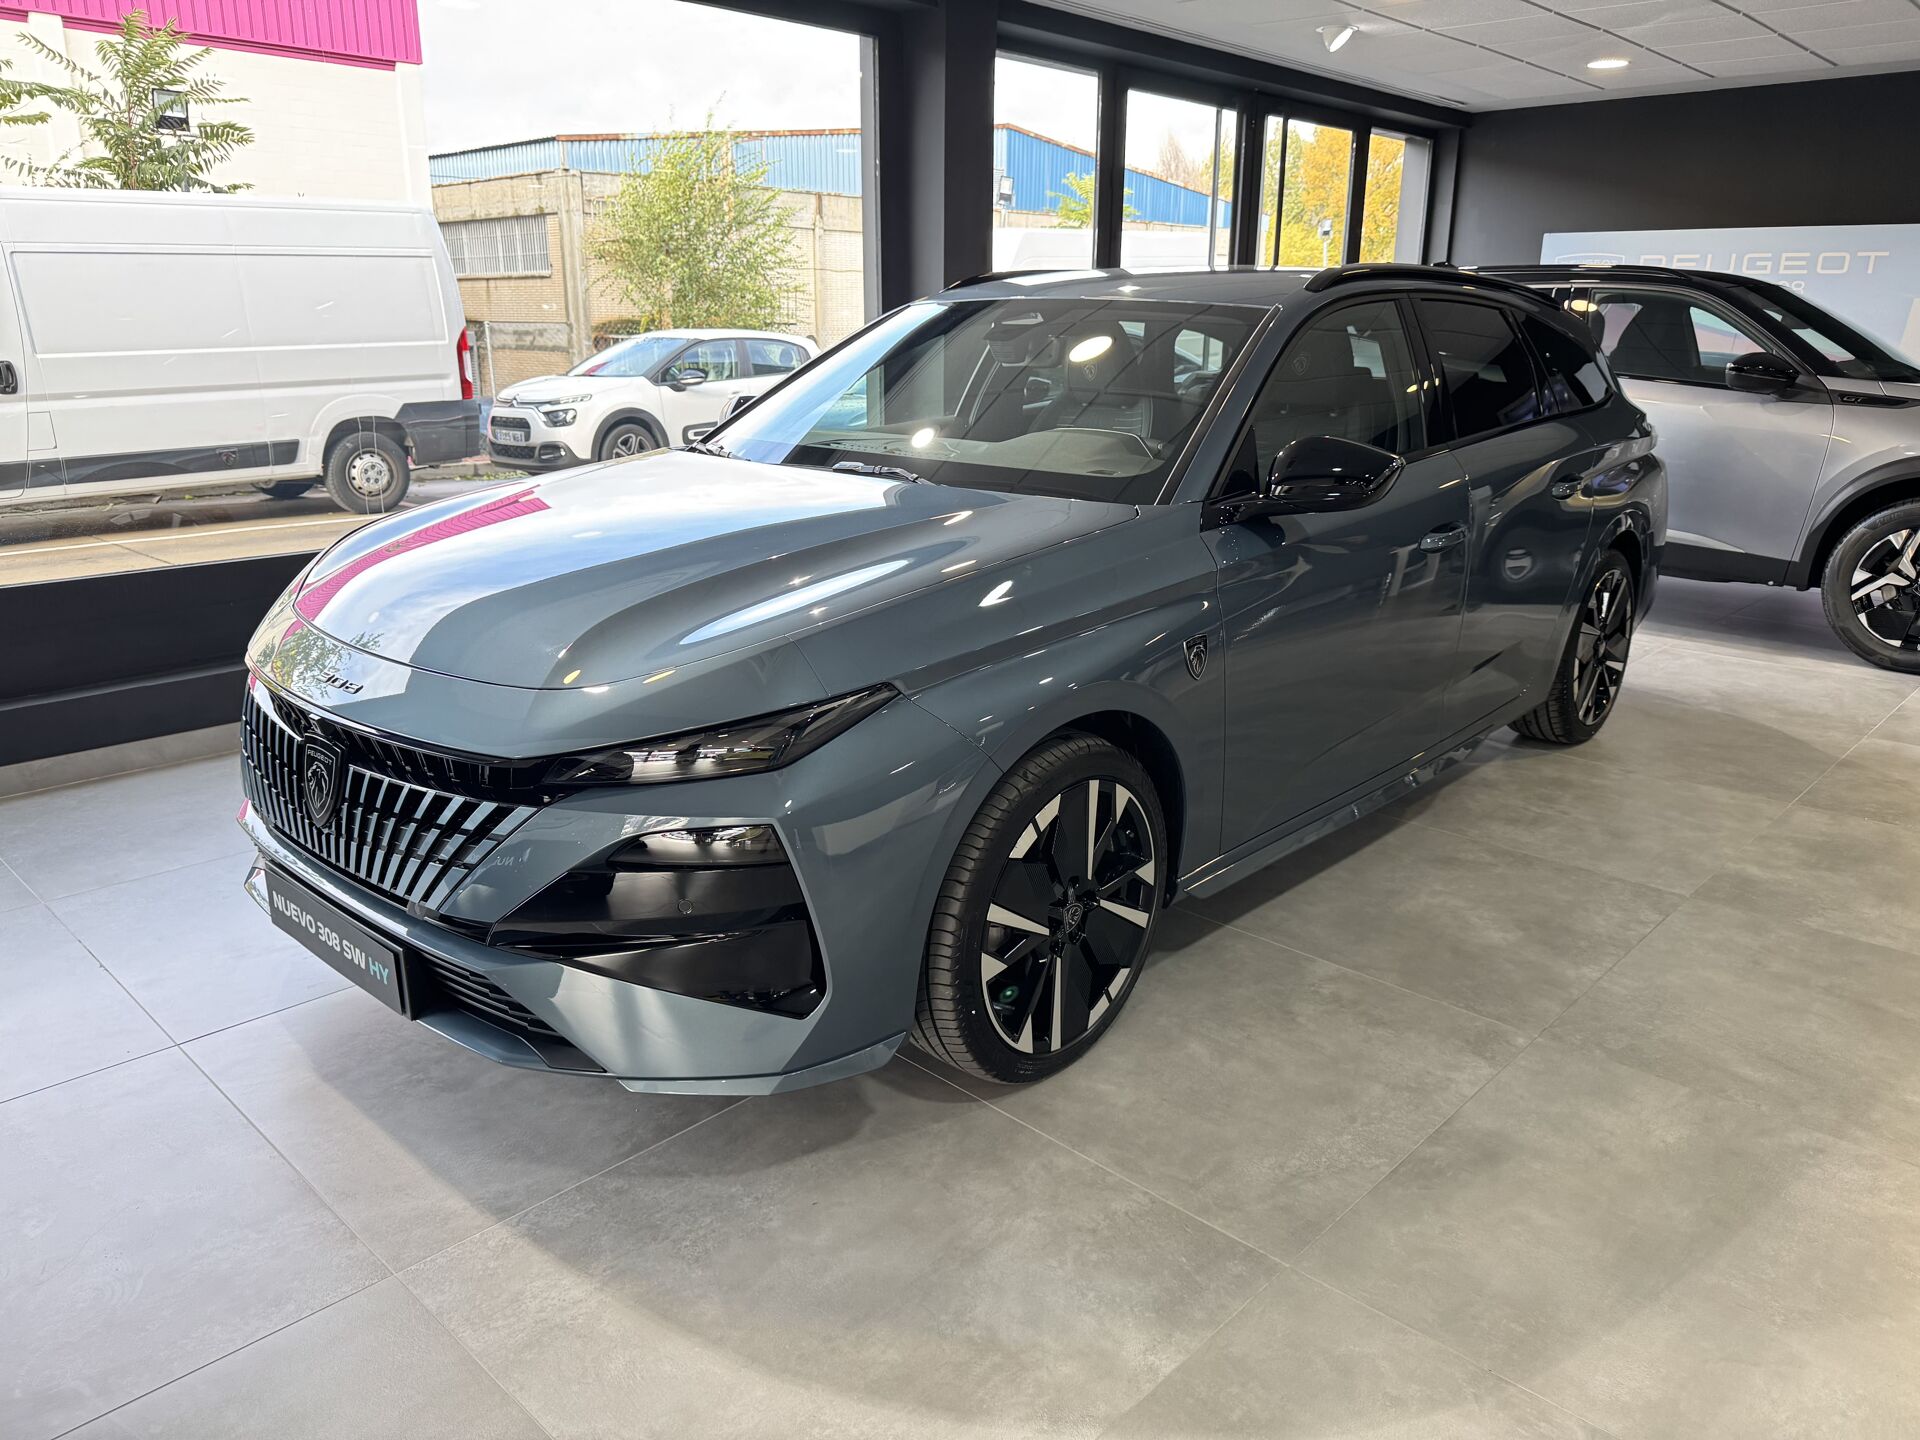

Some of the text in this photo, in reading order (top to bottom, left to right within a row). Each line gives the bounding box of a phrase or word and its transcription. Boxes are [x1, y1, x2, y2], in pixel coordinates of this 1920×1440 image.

[1639, 251, 1890, 274] PEUGEOT
[317, 672, 363, 694] 308
[307, 749, 333, 766] PEUGEOT
[272, 890, 389, 985] NUEVO 308 SW HY
